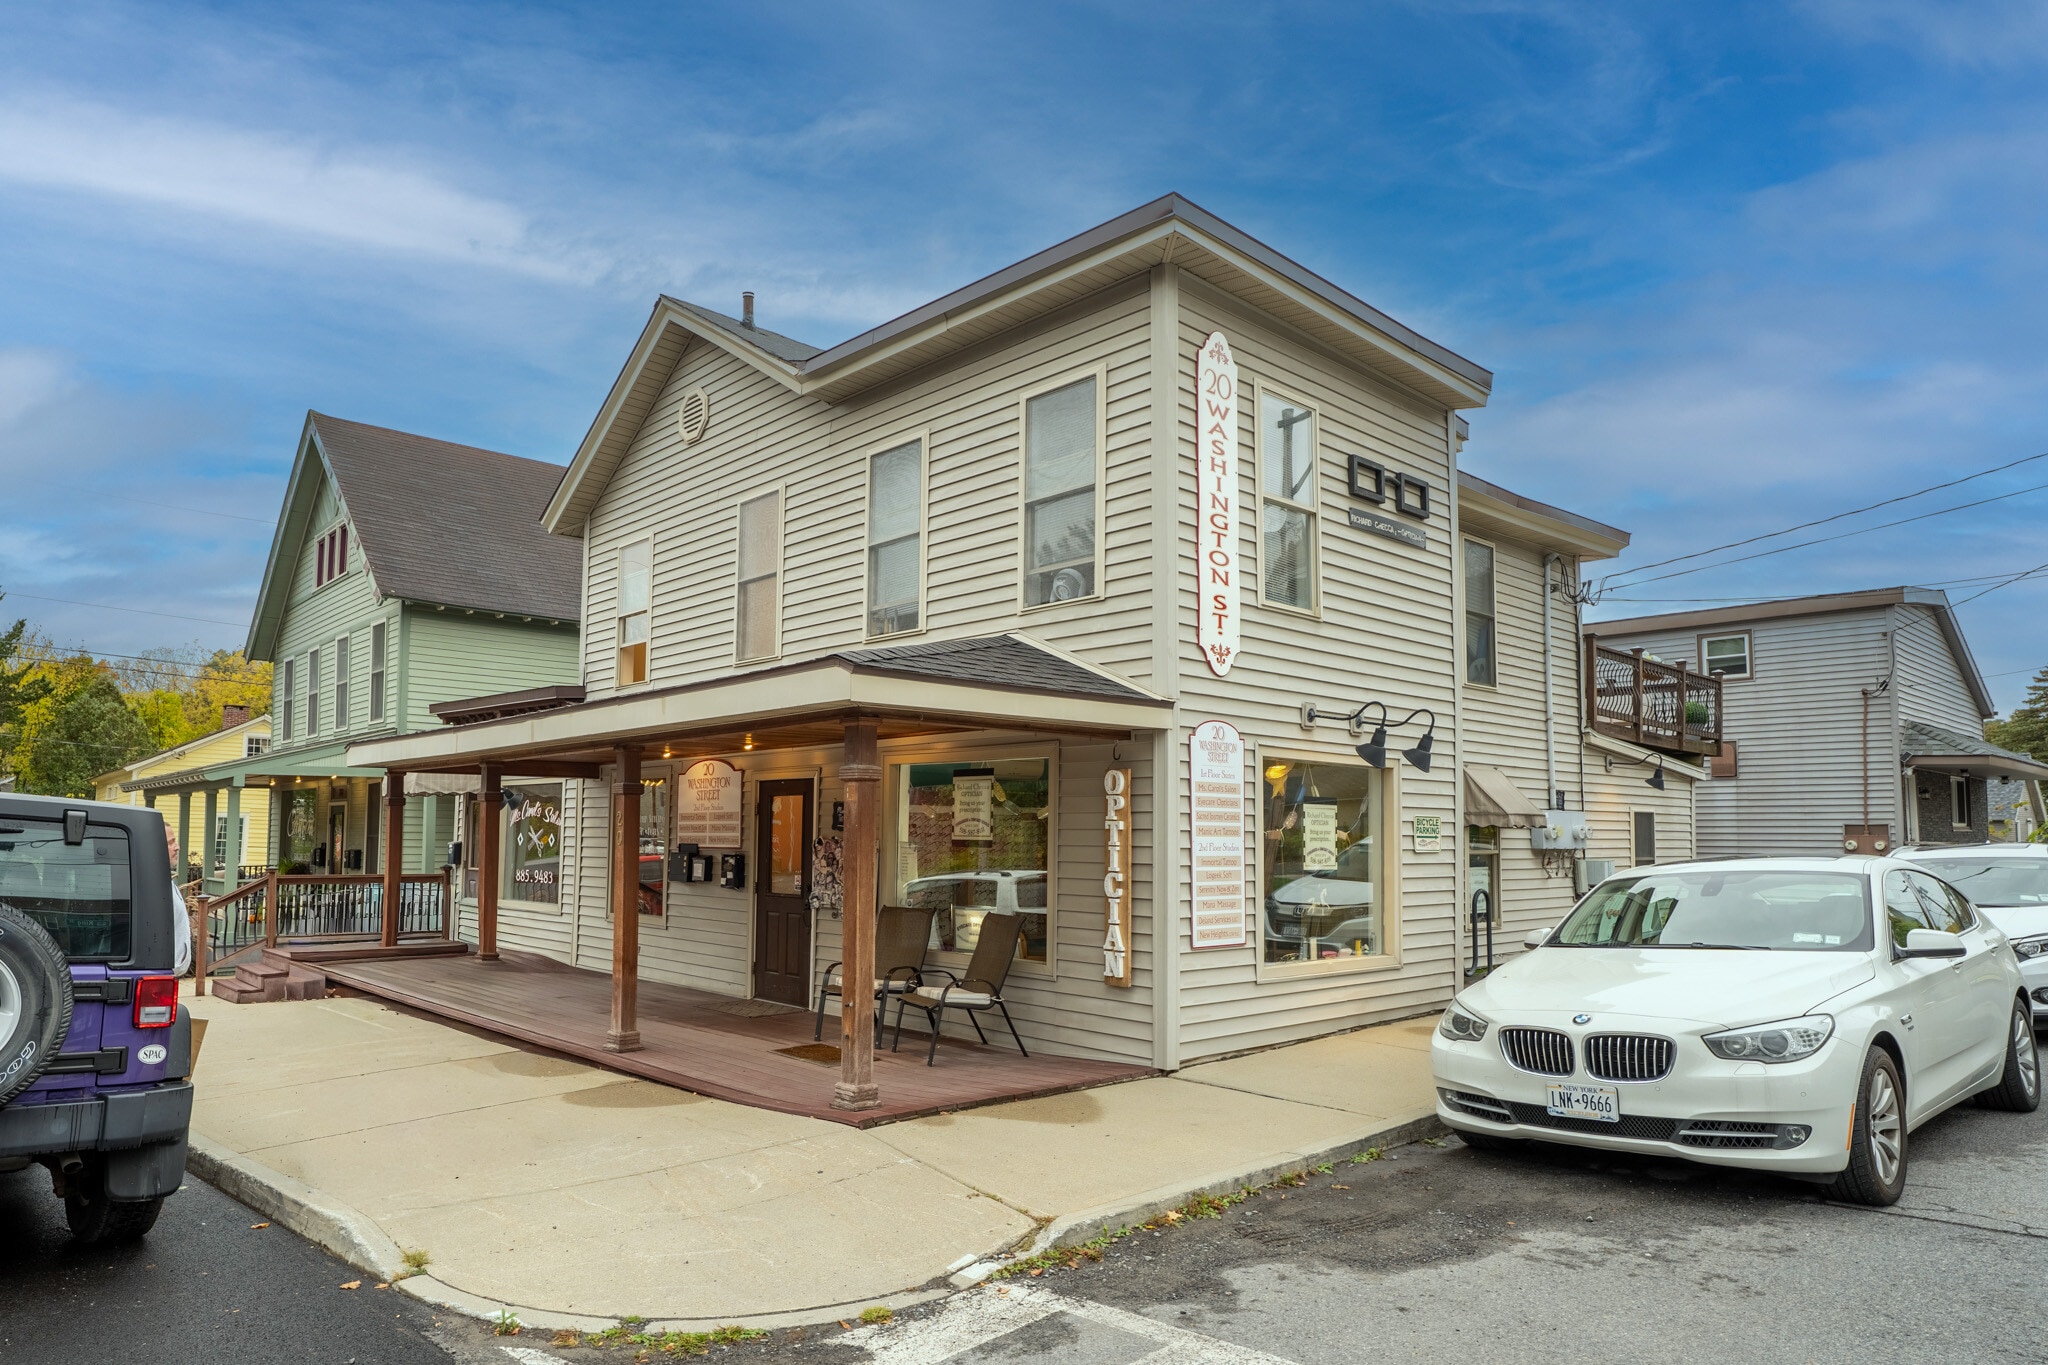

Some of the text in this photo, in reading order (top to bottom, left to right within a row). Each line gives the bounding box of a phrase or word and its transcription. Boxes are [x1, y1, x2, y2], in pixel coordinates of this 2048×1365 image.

[1204, 369, 1231, 400] 20
[1206, 398, 1230, 636] WASHINGTON ST.
[1351, 514, 1372, 527] RICHARD
[1211, 725, 1225, 740] 20
[1199, 740, 1237, 753] WASHINGTON
[1207, 752, 1229, 763] STREET
[703, 763, 715, 776] 20
[1207, 769, 1221, 779] Floor
[688, 777, 731, 789] WASHINGTON
[1224, 785, 1237, 793] Salon
[696, 789, 720, 803] STREET
[1416, 818, 1439, 826] BICYCLE
[1416, 827, 1439, 835] PARKING
[1198, 843, 1208, 852] 2nd
[1209, 842, 1221, 852] Floor
[1222, 858, 1237, 866] Tattoo
[516, 869, 553, 884] 885.9483
[1103, 770, 1125, 978] OPTICIAN
[1199, 931, 1210, 939] New
[143, 1049, 163, 1060] SPAC
